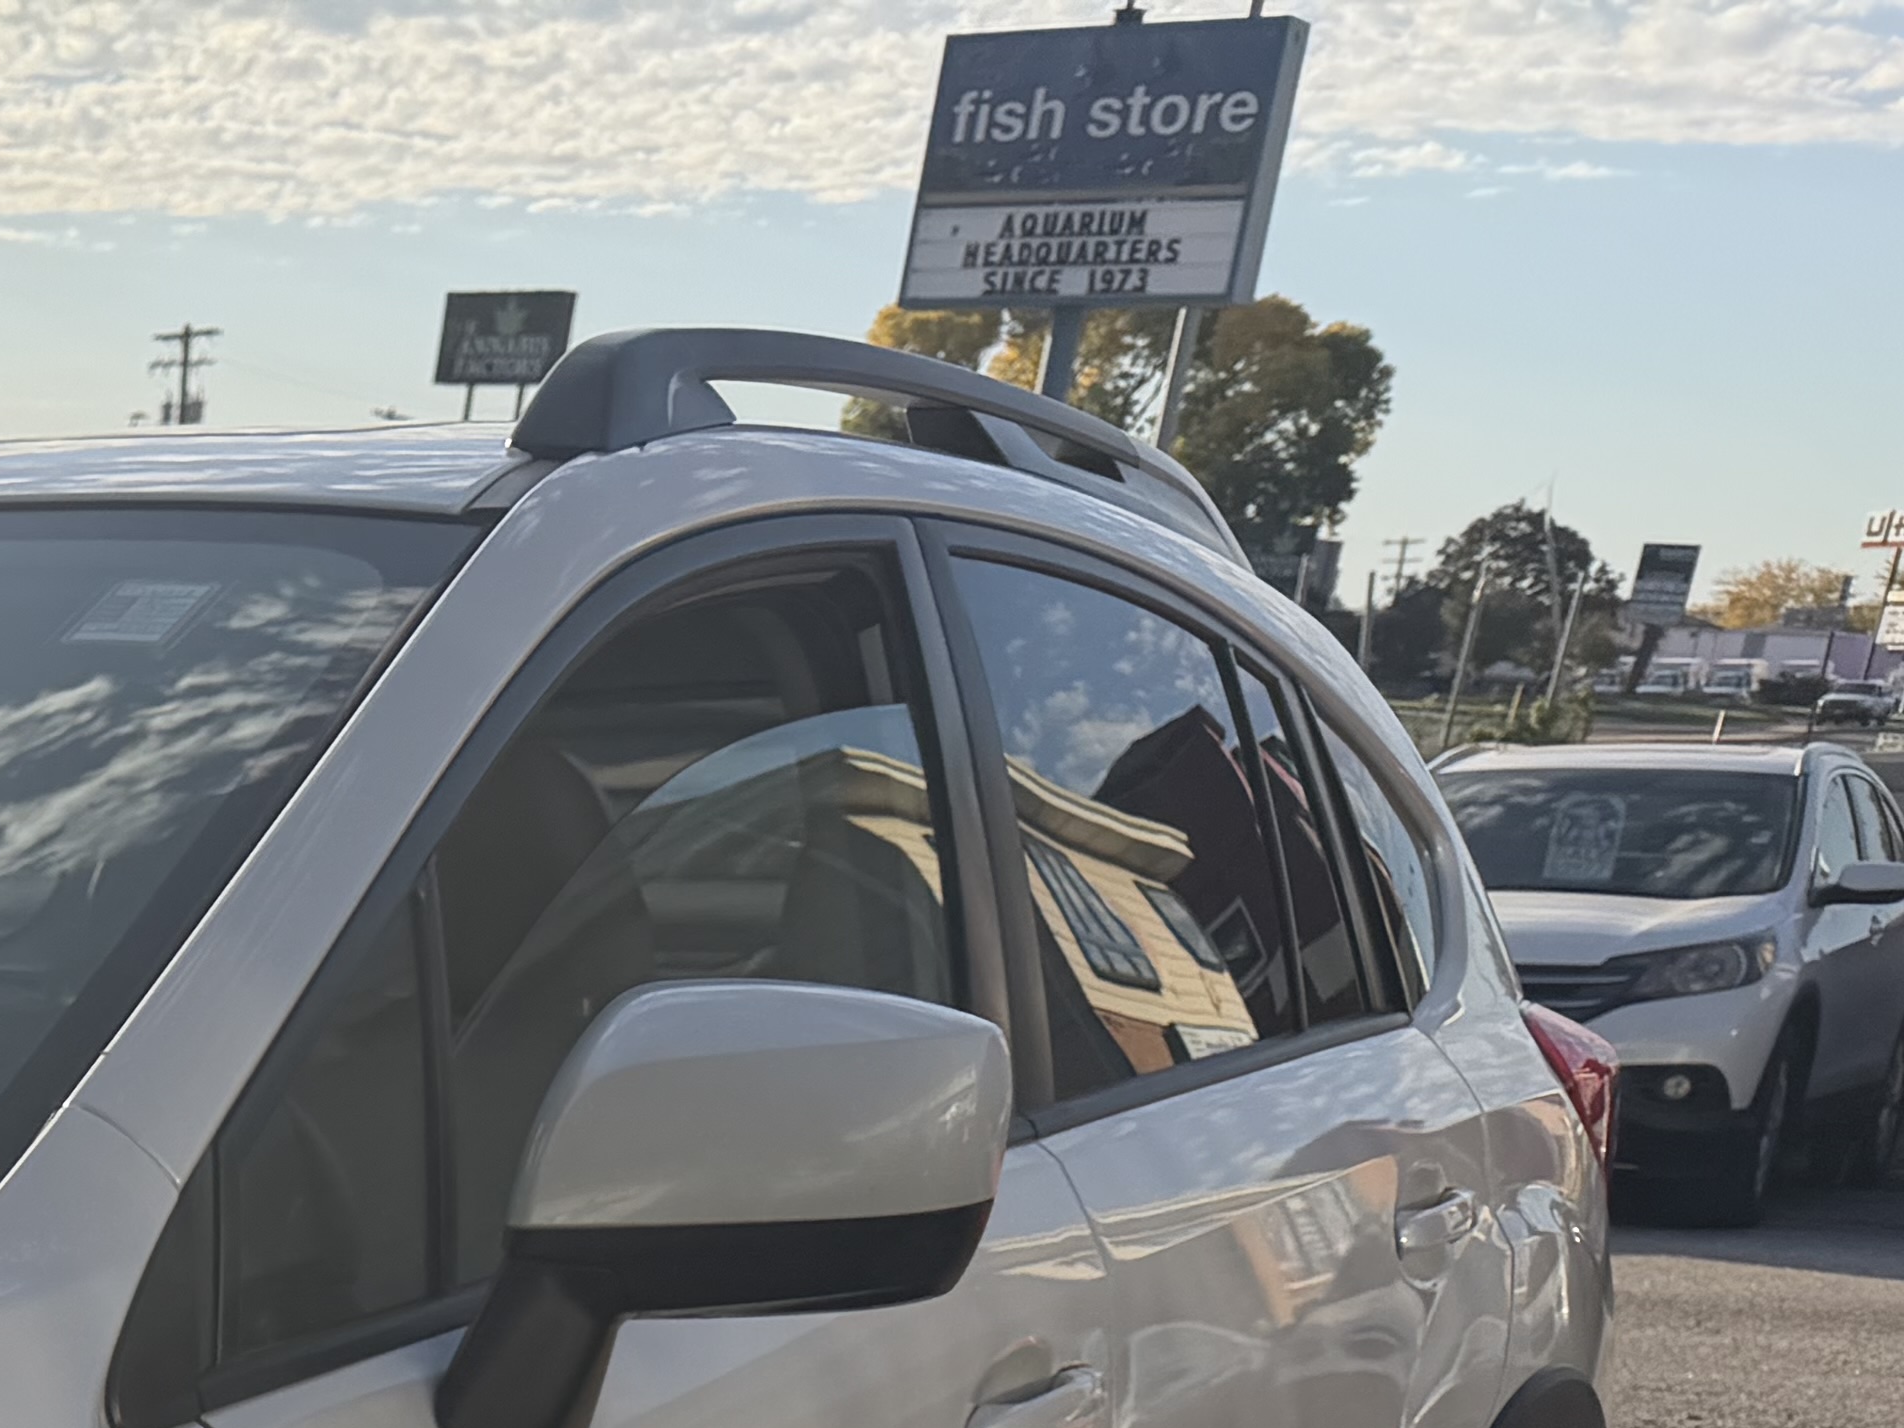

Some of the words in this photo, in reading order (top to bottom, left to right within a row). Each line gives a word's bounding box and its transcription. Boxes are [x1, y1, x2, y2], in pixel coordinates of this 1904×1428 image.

[951, 87, 1066, 143] fish
[1085, 84, 1259, 137] store
[997, 209, 1149, 240] AQUARIUM
[960, 237, 1182, 269] HEADQUARTERS
[981, 268, 1063, 296] SINCE
[1086, 266, 1149, 294] 1973
